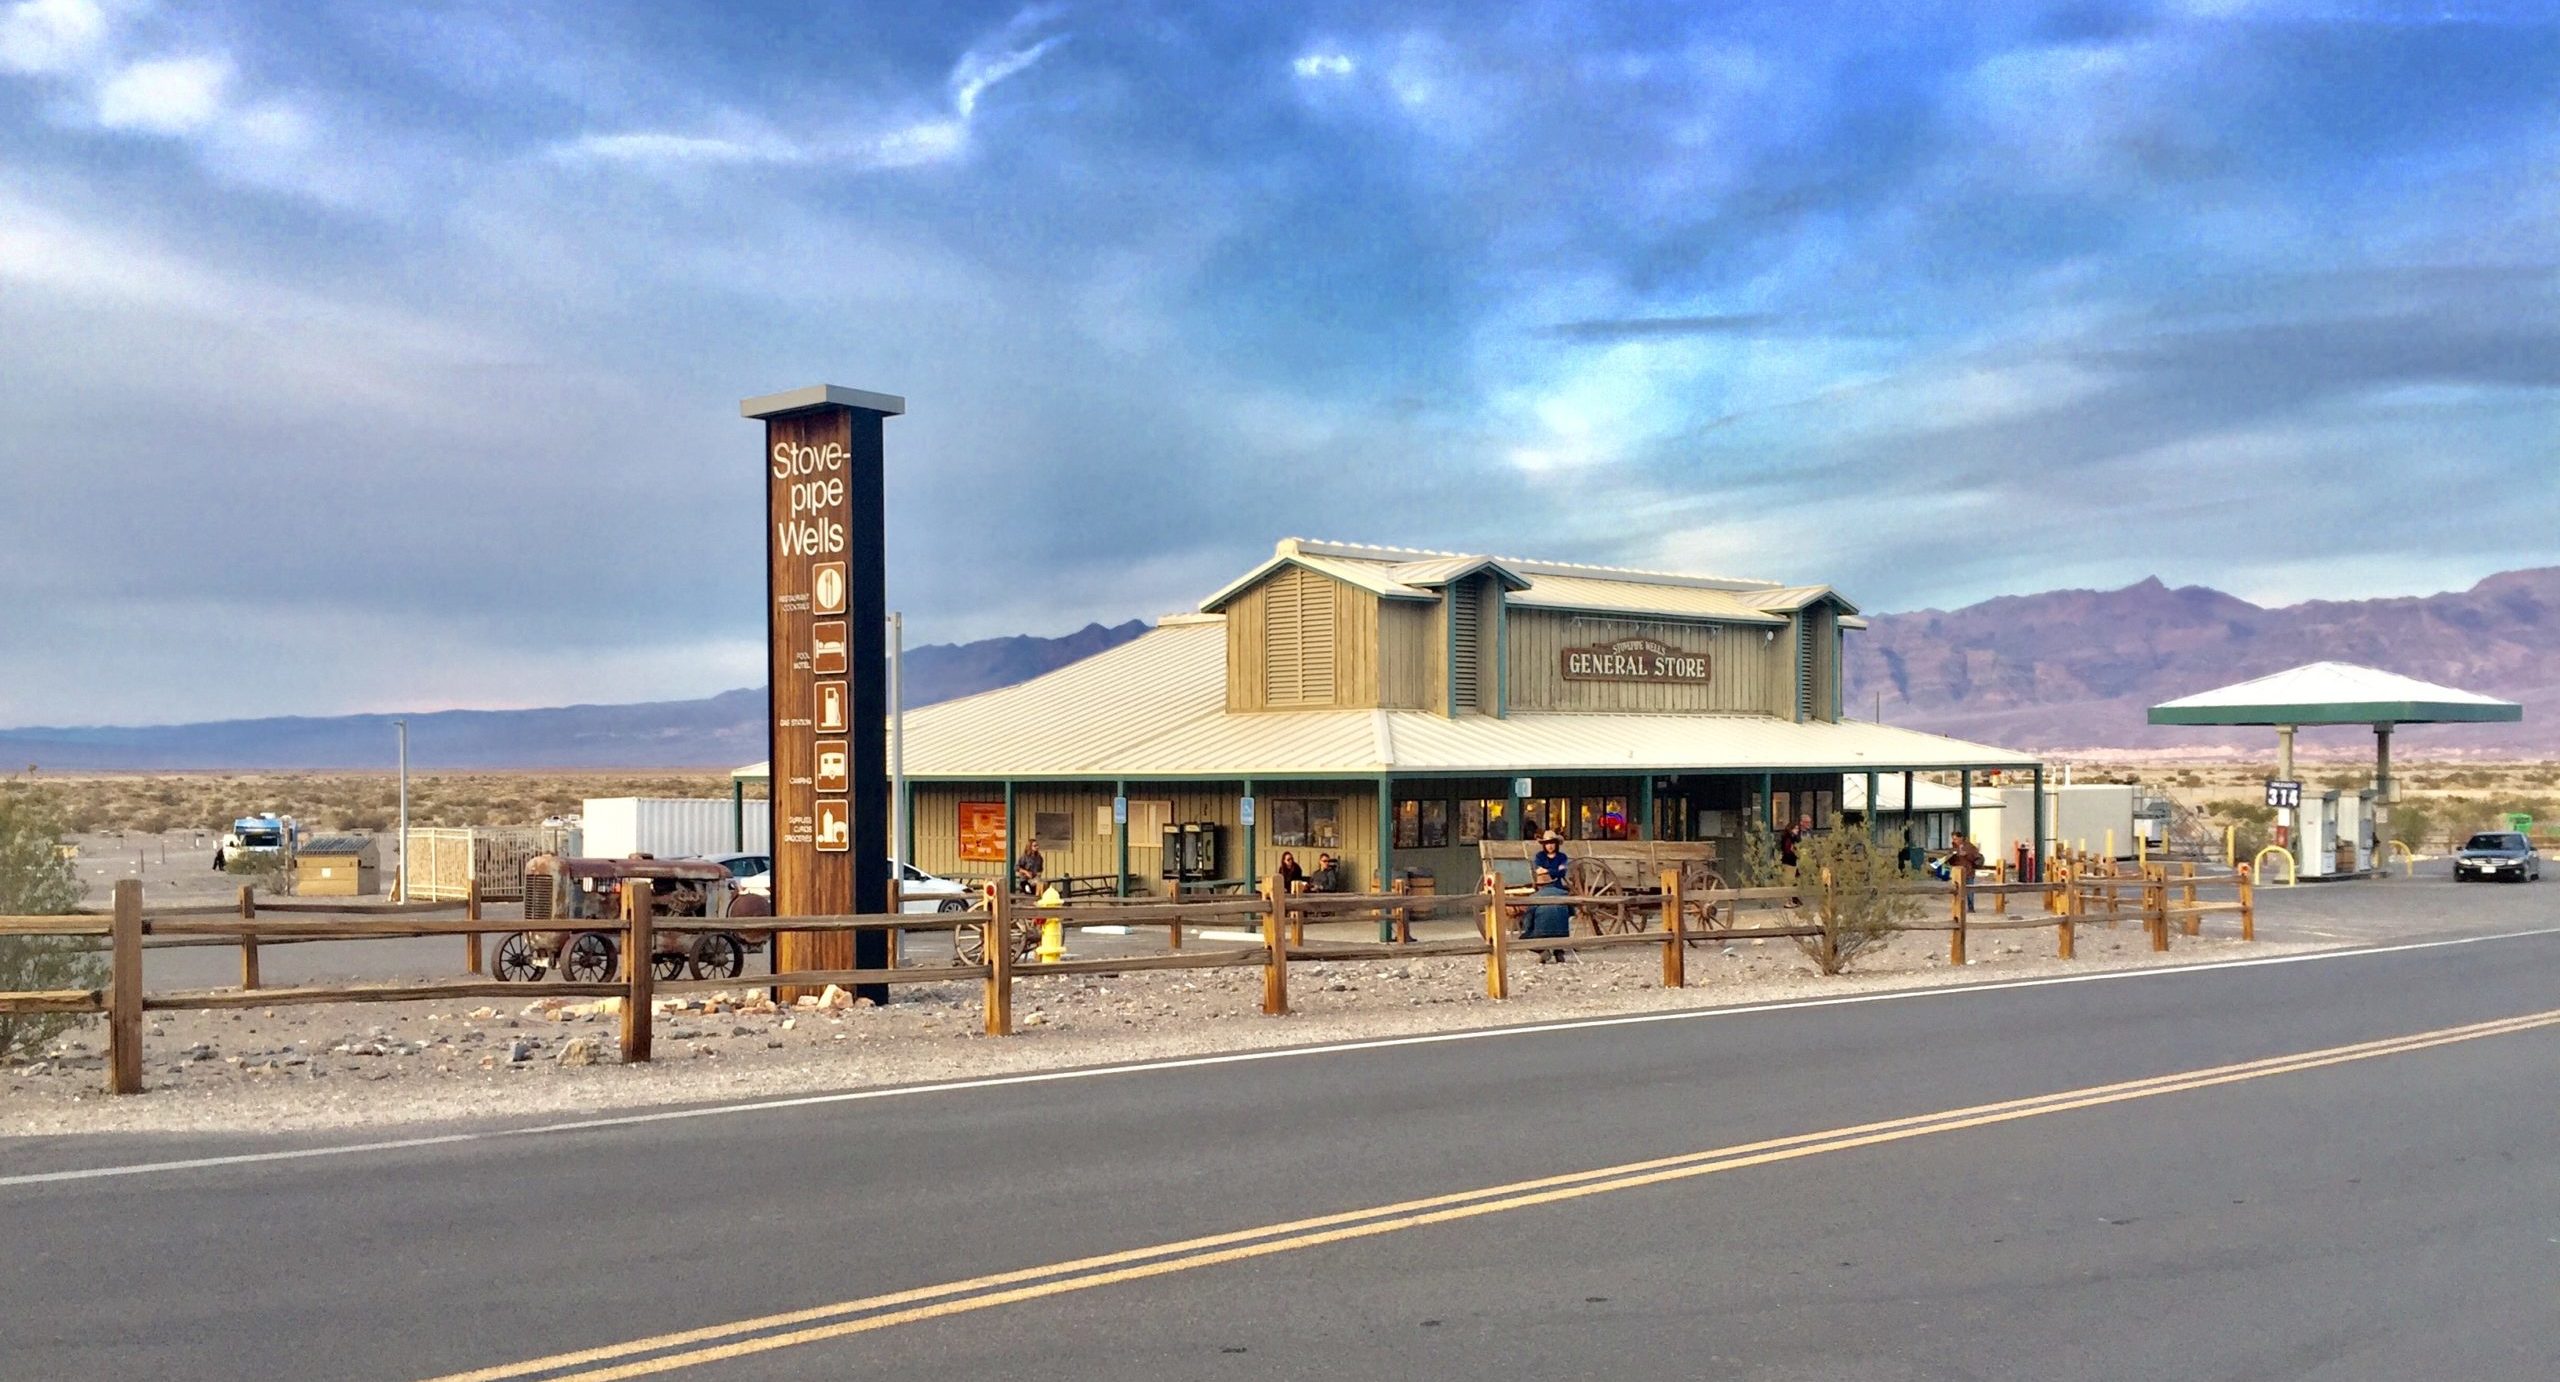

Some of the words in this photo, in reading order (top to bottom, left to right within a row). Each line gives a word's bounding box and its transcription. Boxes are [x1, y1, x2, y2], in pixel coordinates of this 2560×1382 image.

[773, 441, 852, 479] Stove-
[791, 477, 844, 519] pipe
[778, 516, 845, 557] Wells
[1569, 653, 1648, 676] GENERAL
[1654, 656, 1706, 678] STORE
[1645, 640, 1666, 656] WELLS
